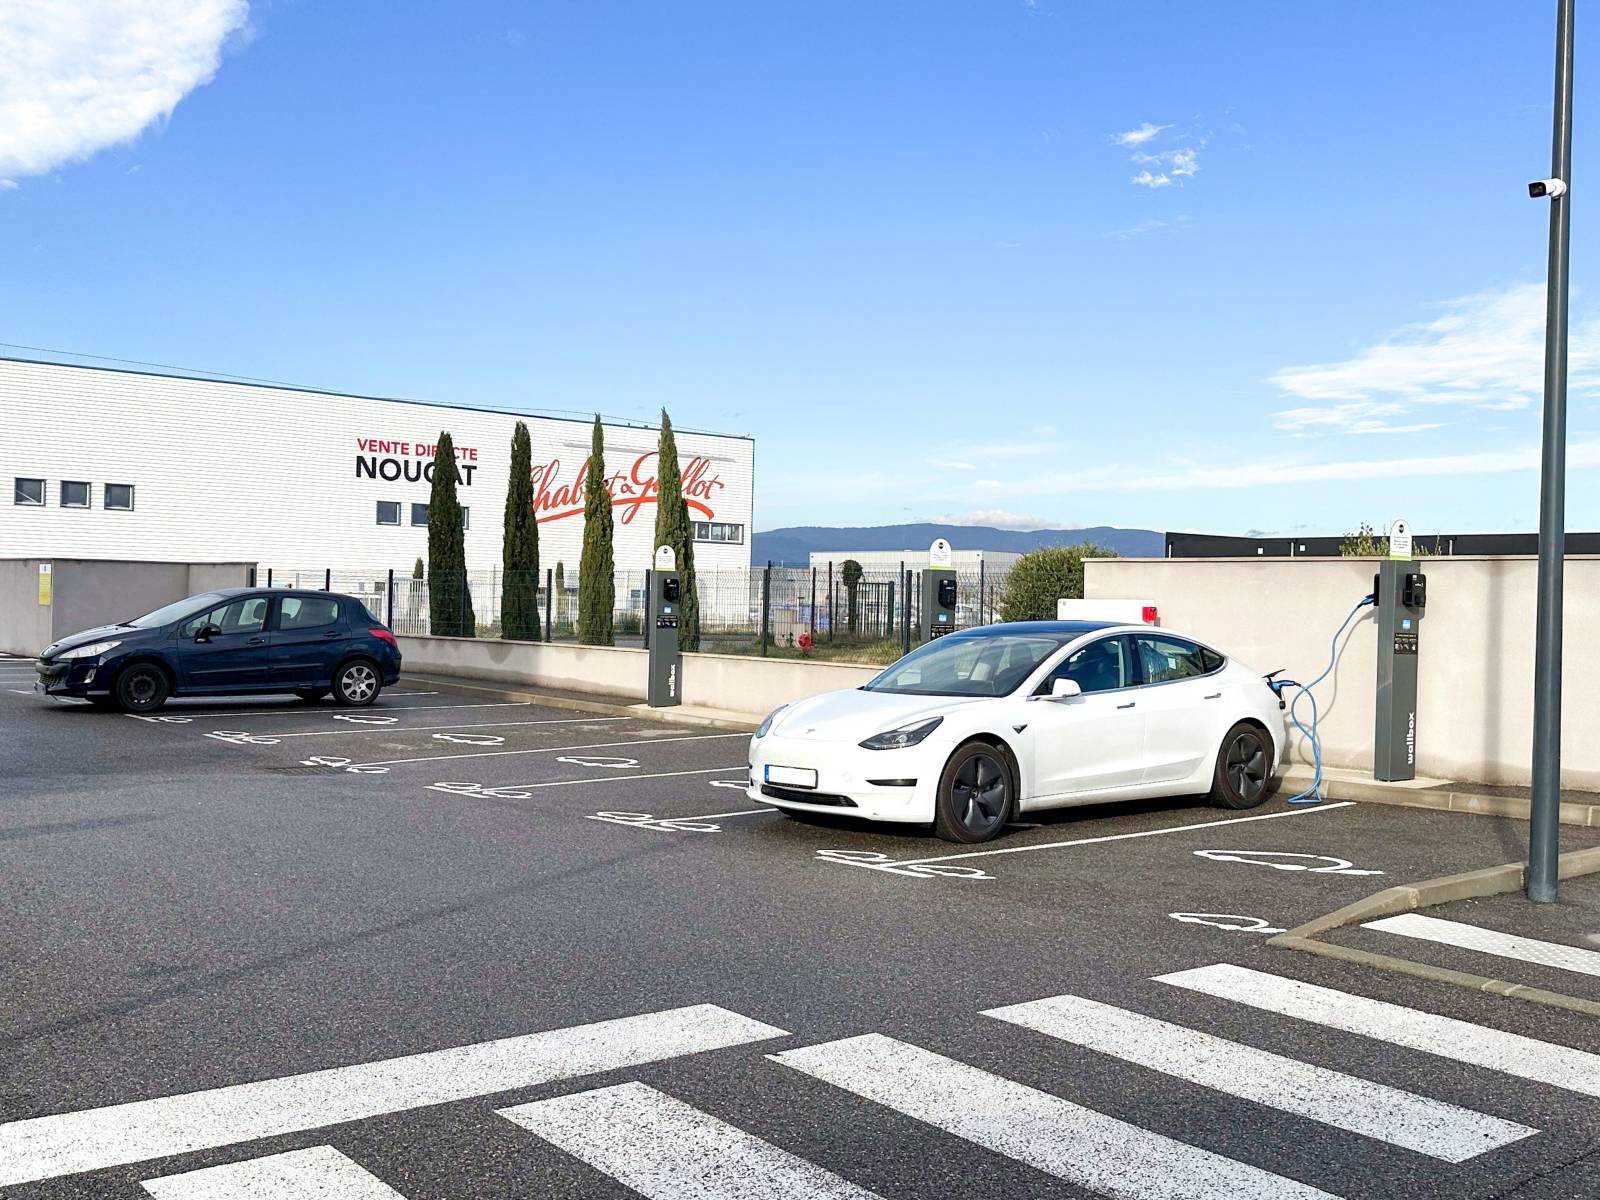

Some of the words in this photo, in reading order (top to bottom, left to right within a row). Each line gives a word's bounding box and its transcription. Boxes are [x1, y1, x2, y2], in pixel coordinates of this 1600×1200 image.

[356, 438, 410, 455] VENTE
[415, 443, 478, 461] DIRCTE
[1406, 711, 1415, 765] wallbox
